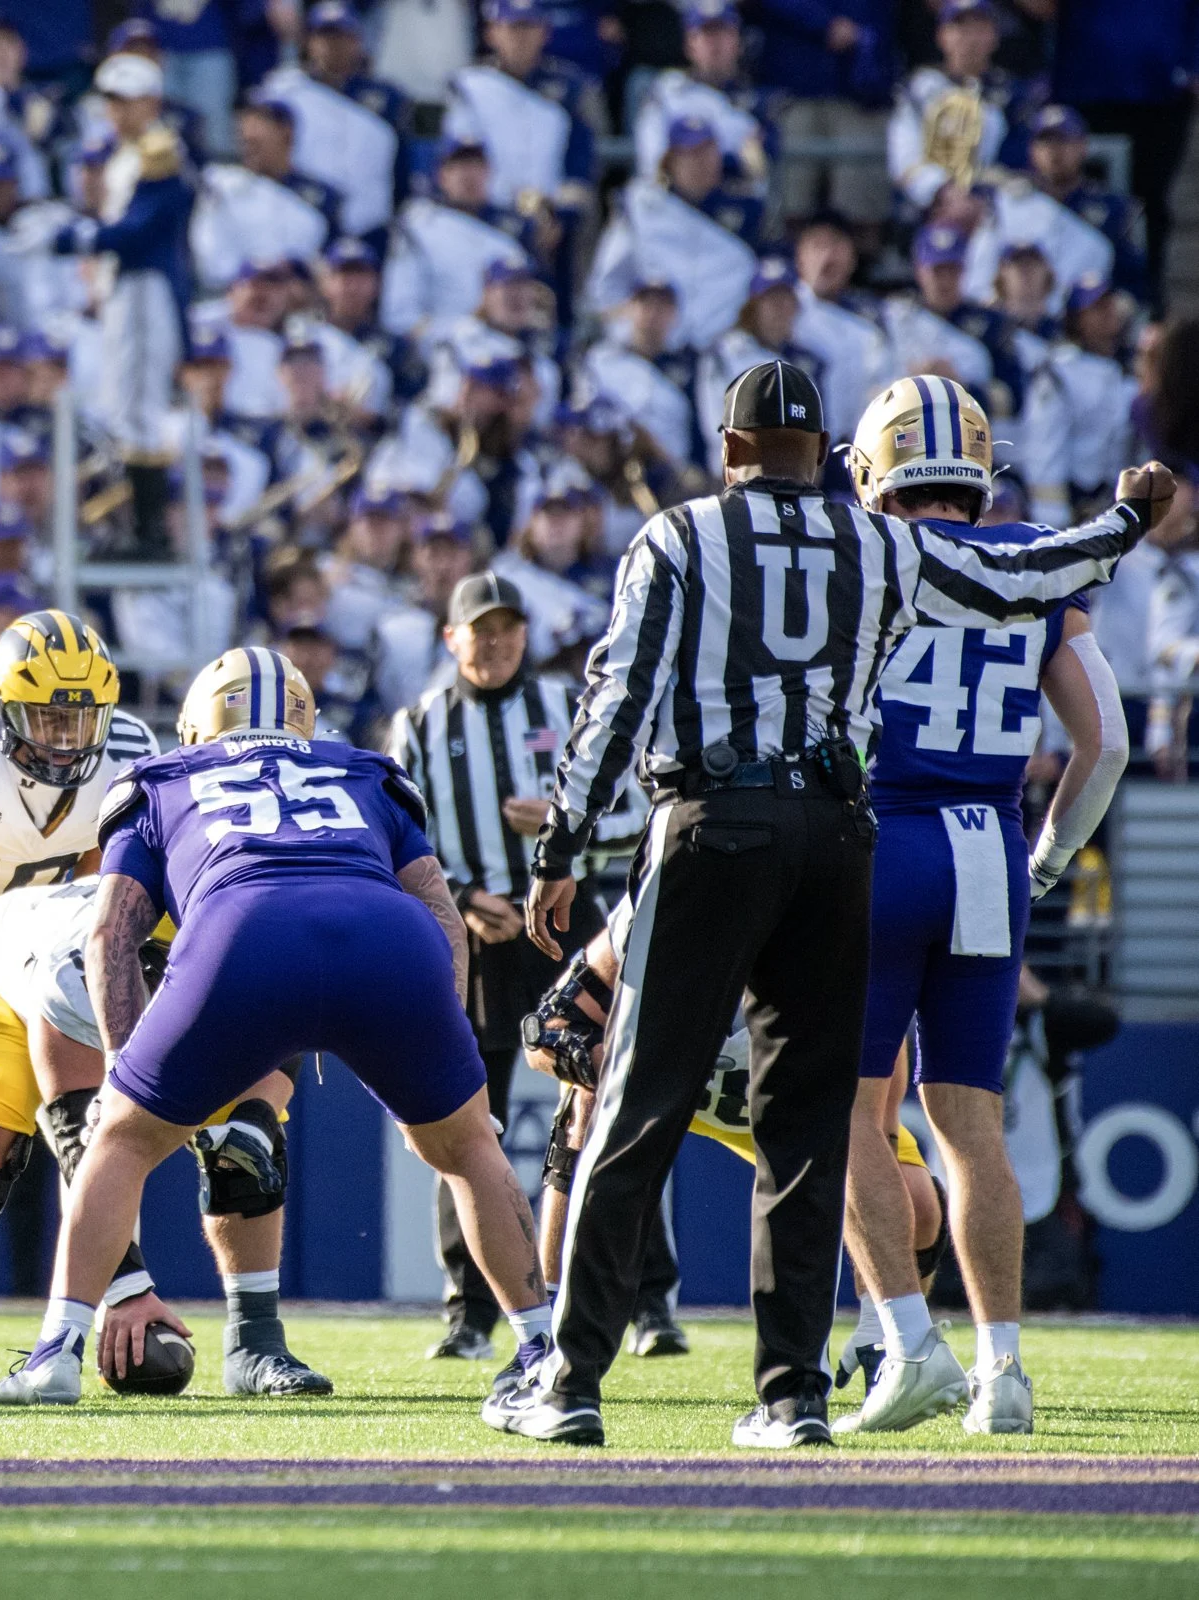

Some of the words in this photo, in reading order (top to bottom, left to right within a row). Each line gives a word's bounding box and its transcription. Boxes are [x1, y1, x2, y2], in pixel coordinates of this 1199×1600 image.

[790, 403, 806, 419] RR
[903, 466, 984, 480] WASHINGTON
[781, 503, 796, 517] S
[755, 544, 836, 662] U
[68, 690, 82, 703] M
[878, 618, 1047, 757] 42
[791, 771, 806, 789] S
[190, 759, 370, 847] 55
[950, 807, 988, 831] W
